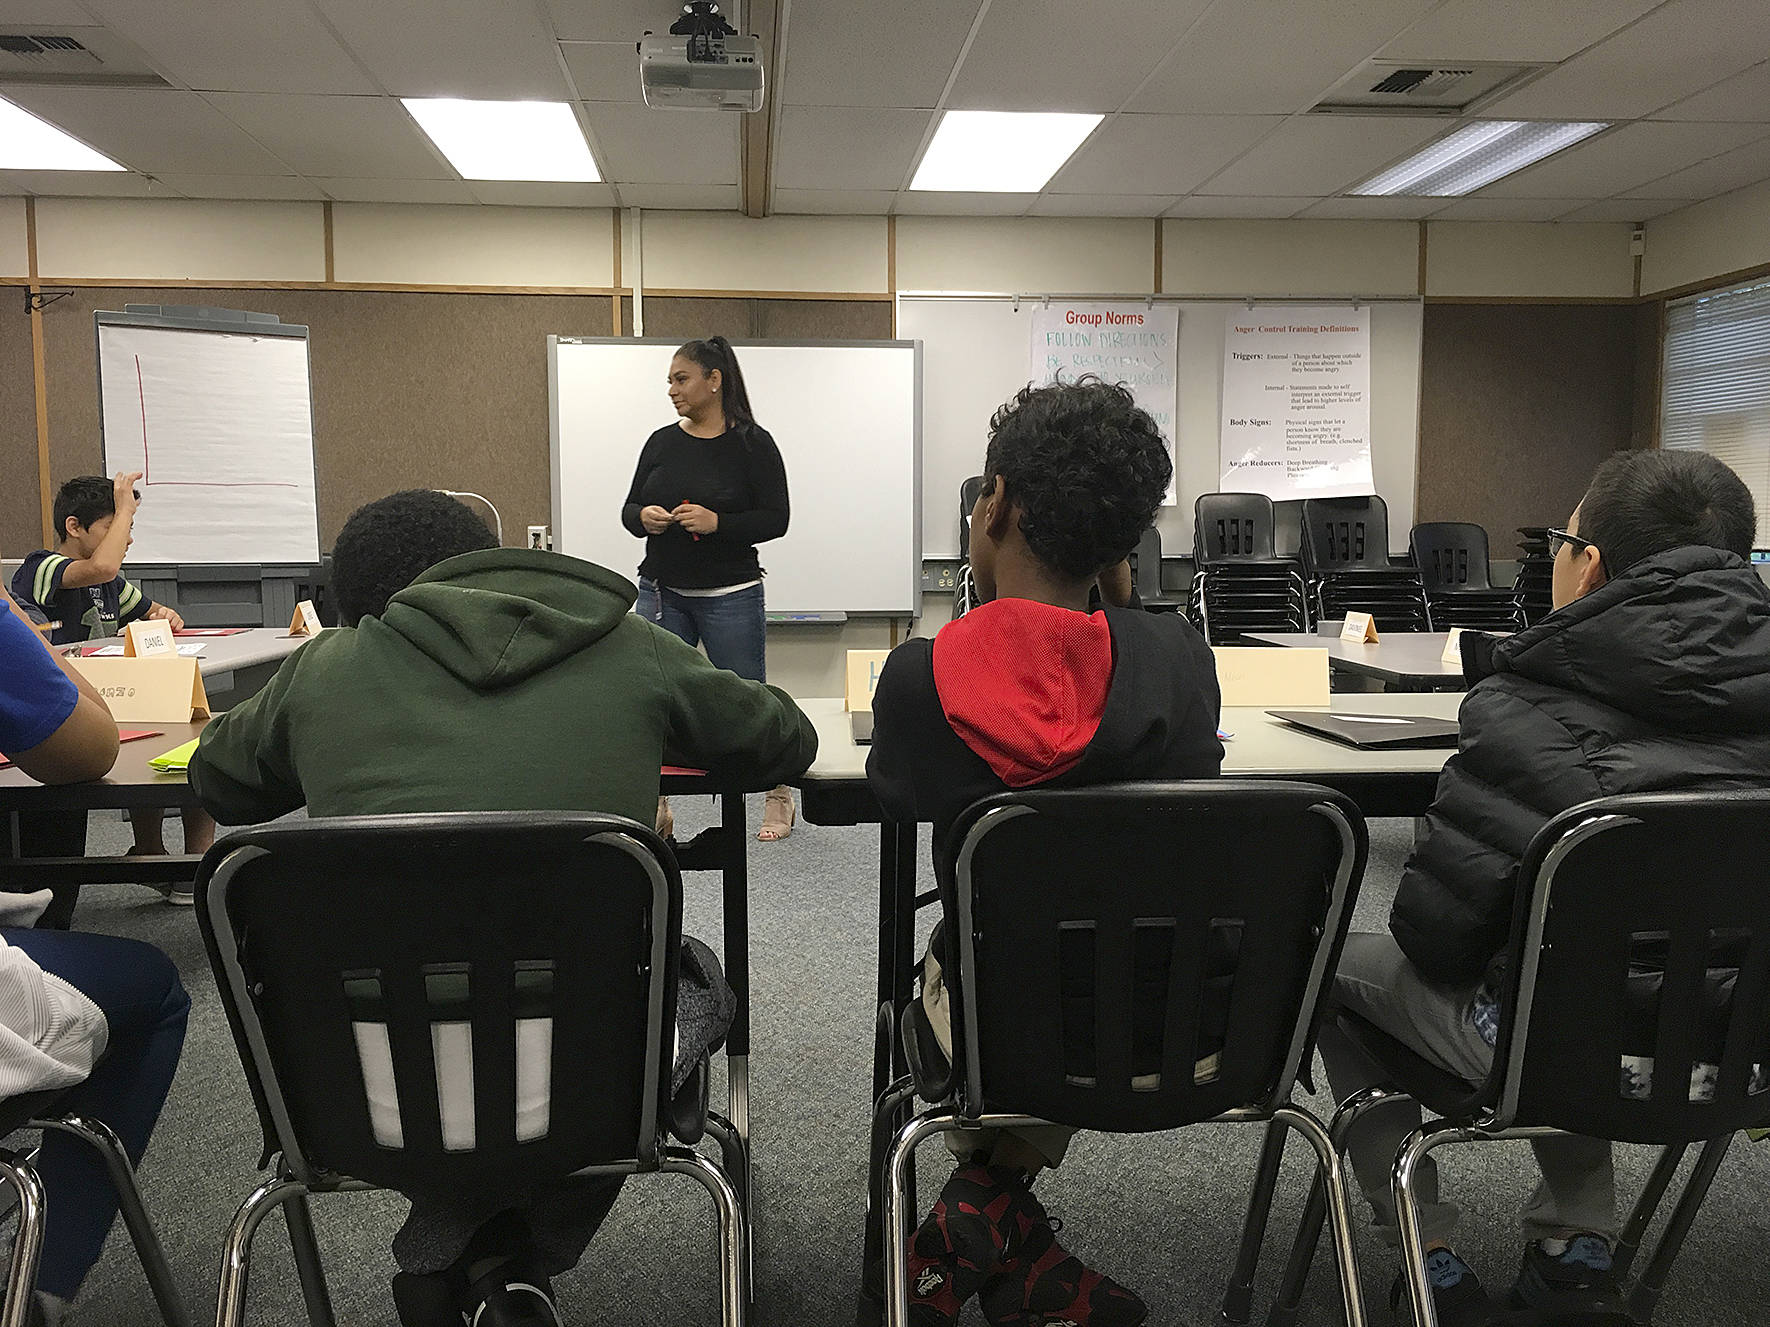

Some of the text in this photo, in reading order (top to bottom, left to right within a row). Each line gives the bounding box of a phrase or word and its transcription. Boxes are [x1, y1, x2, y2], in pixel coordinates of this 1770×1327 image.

[1065, 310, 1144, 328] Group Norms
[1288, 325, 1318, 334] Training
[1046, 332, 1167, 348] FOLLOW DIRECTIONS
[1232, 352, 1264, 360] Triggers:
[144, 635, 164, 649] DANIEL
